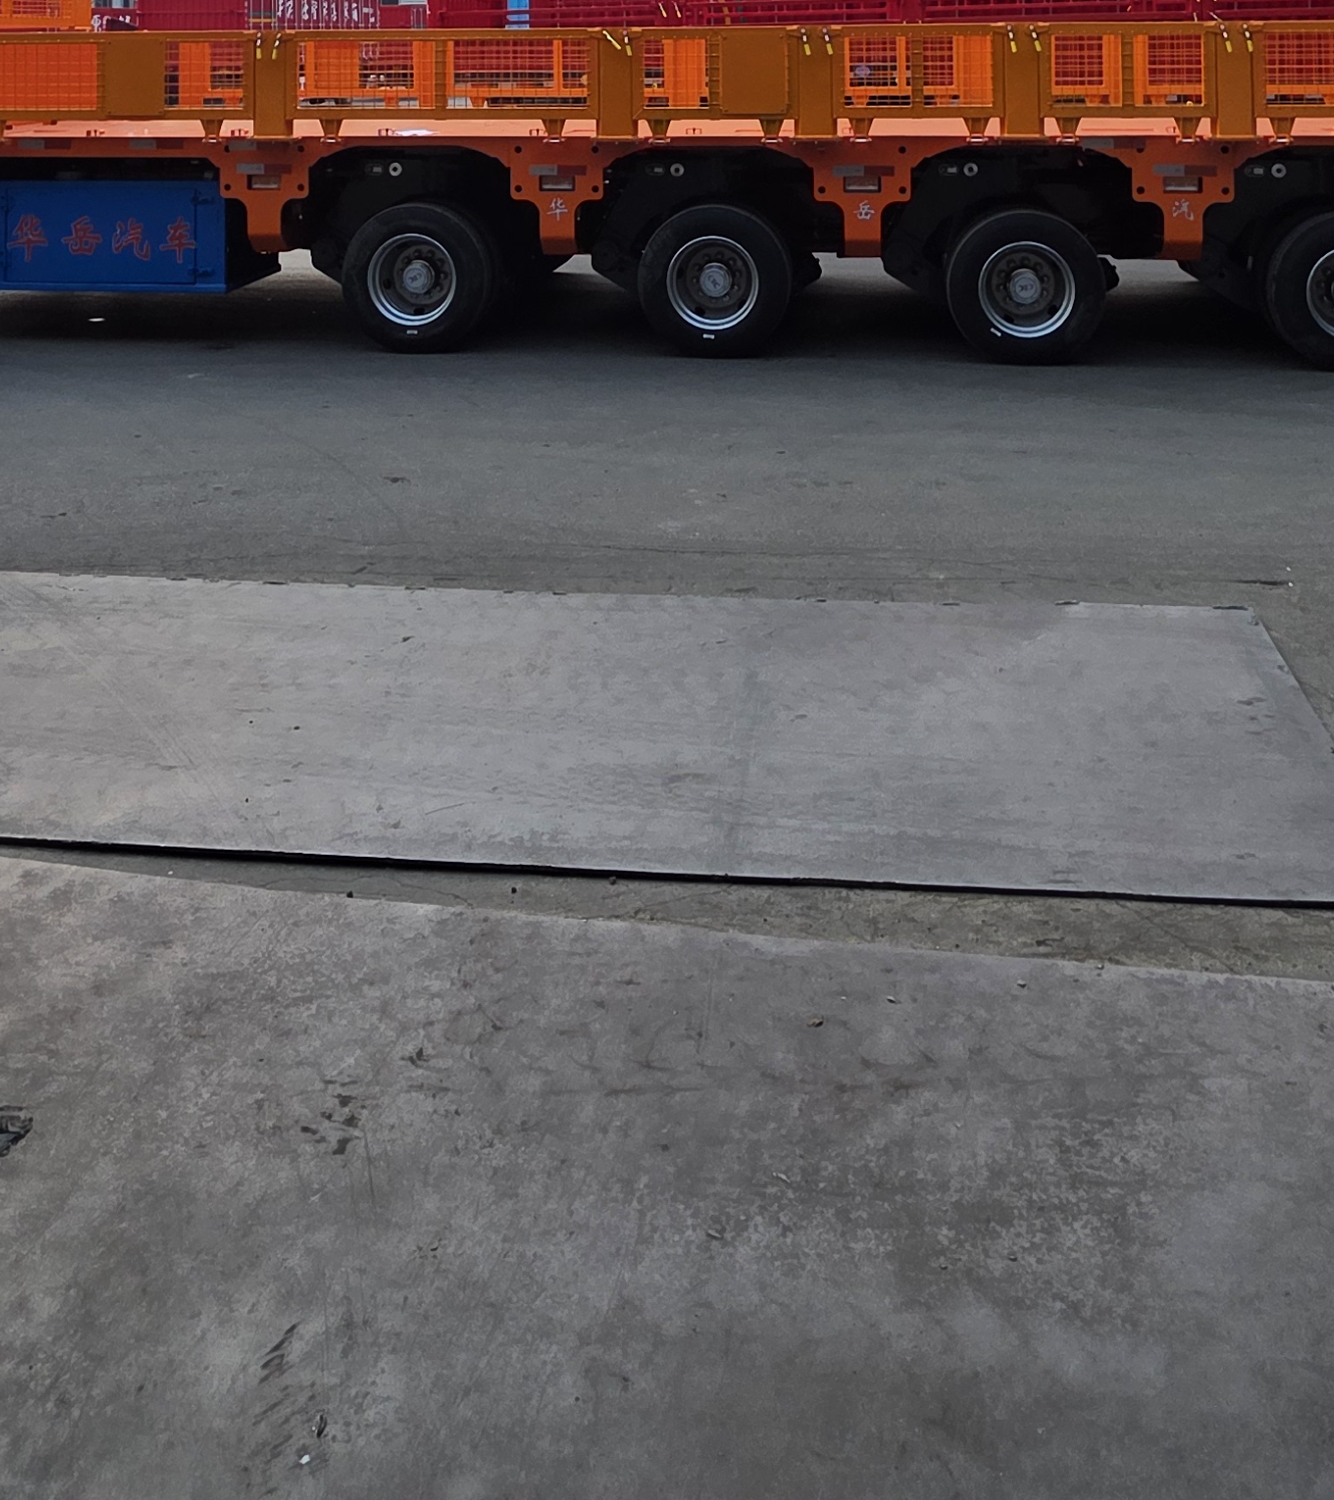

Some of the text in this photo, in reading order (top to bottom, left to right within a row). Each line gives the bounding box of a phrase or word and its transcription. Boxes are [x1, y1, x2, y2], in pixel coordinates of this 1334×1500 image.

[547, 197, 568, 221] 华
[853, 200, 875, 220] 岳
[1172, 199, 1194, 221] 汽
[7, 215, 197, 263] 华岳汽车
